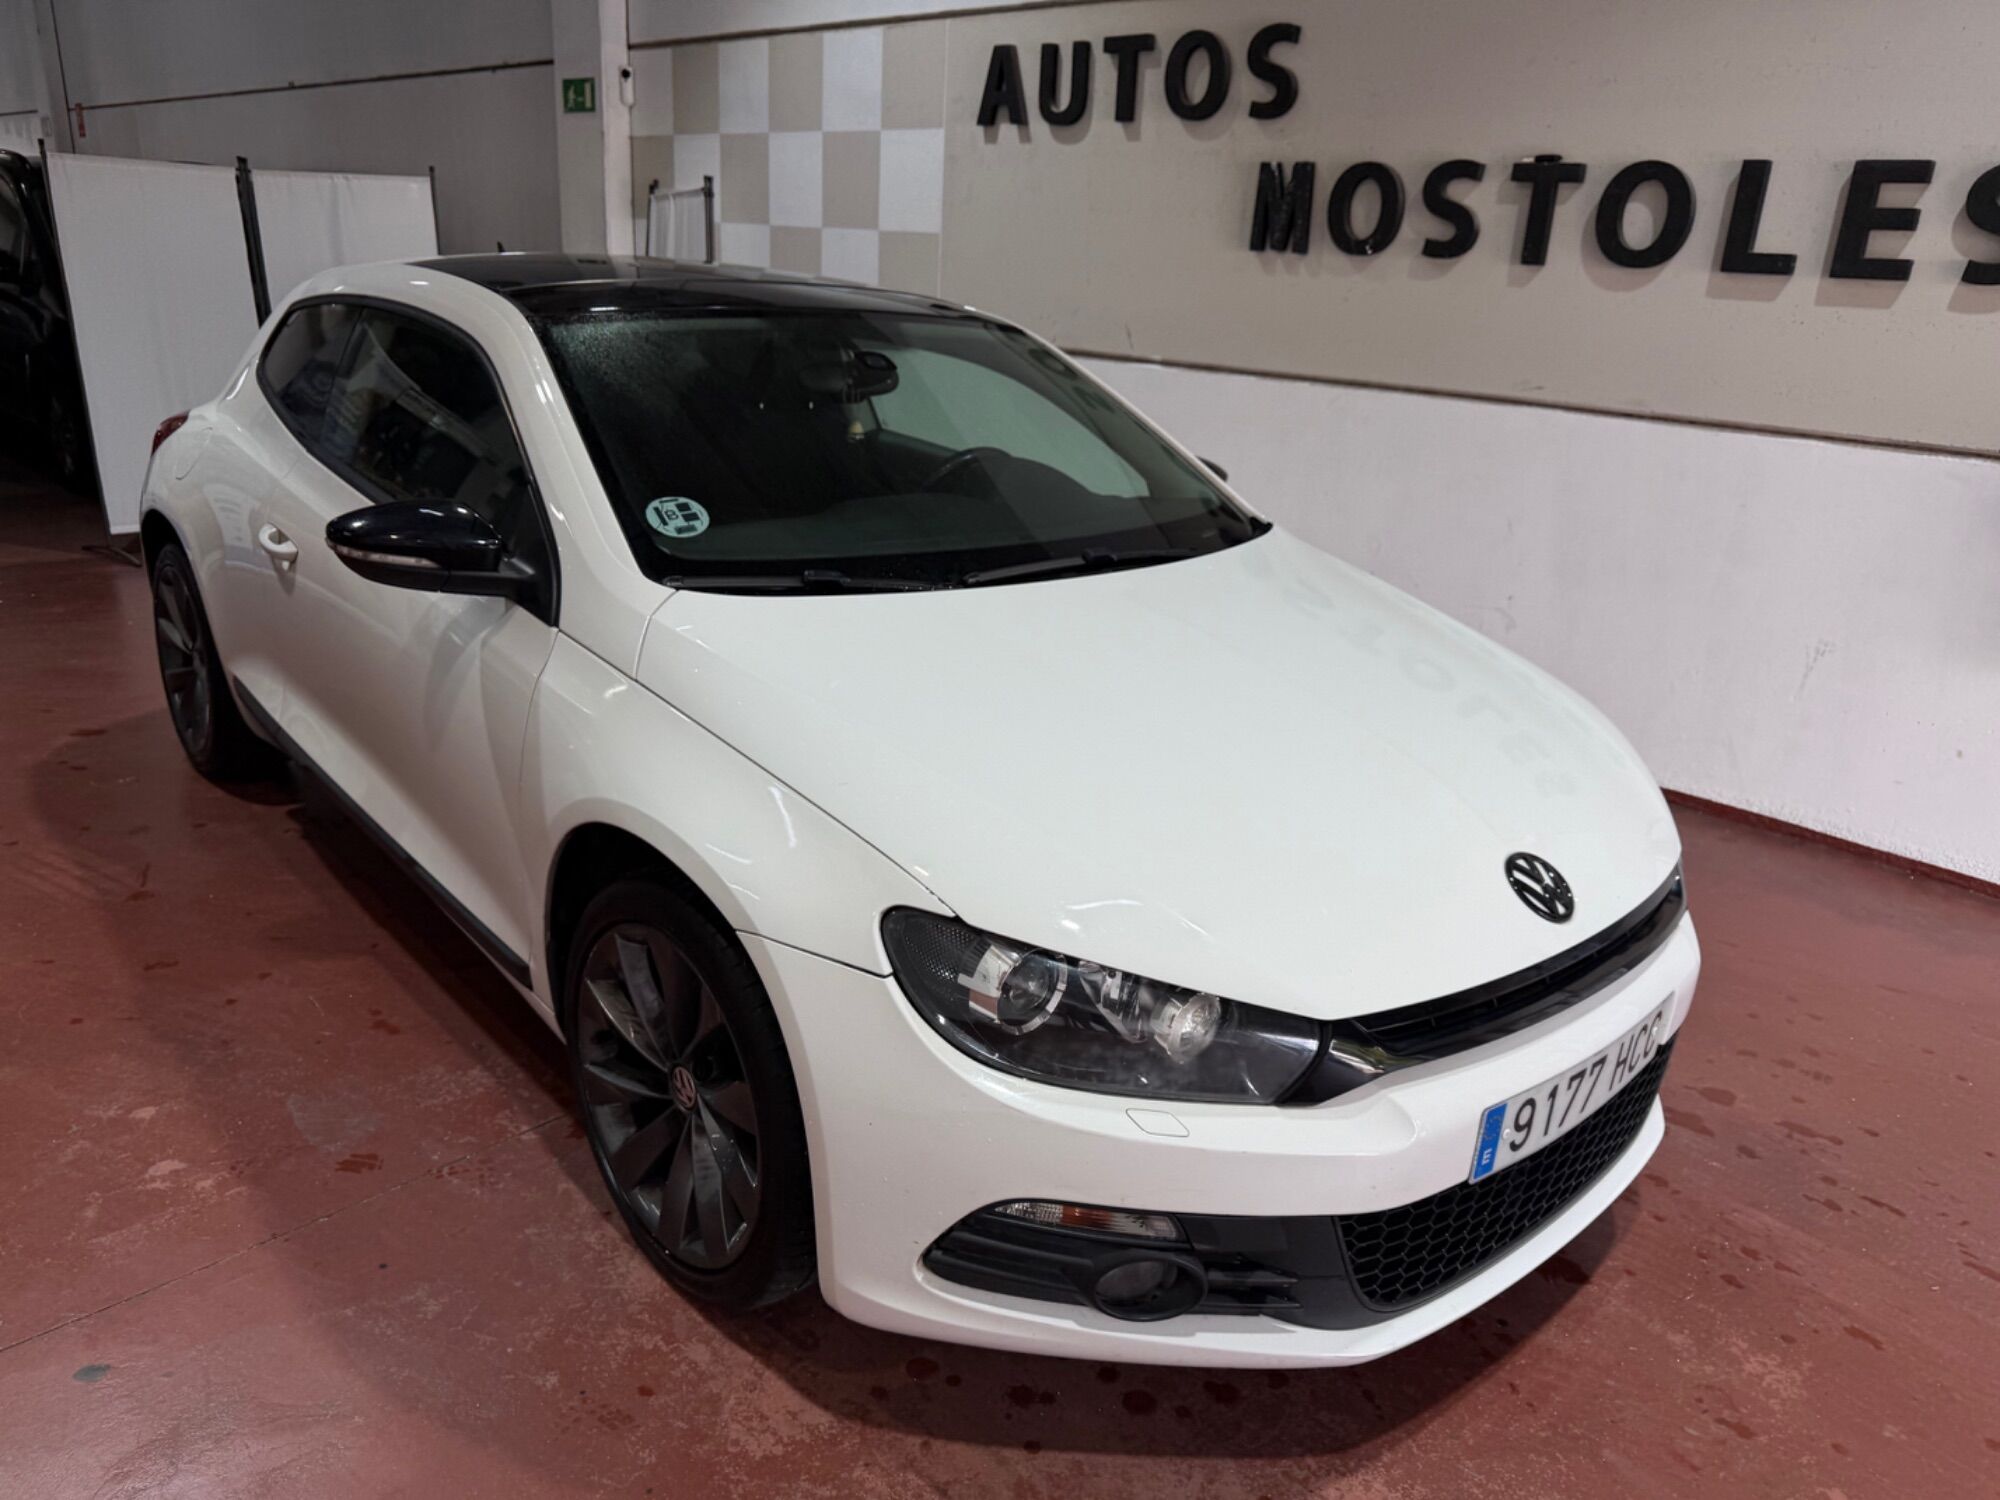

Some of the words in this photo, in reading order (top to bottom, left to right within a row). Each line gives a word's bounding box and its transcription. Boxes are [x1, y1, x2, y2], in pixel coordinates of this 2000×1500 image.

[976, 22, 1302, 127] AUTOS
[1509, 1054, 1608, 1153] 9177
[1608, 1010, 1663, 1092] HCC
[1481, 1147, 1493, 1166] E
